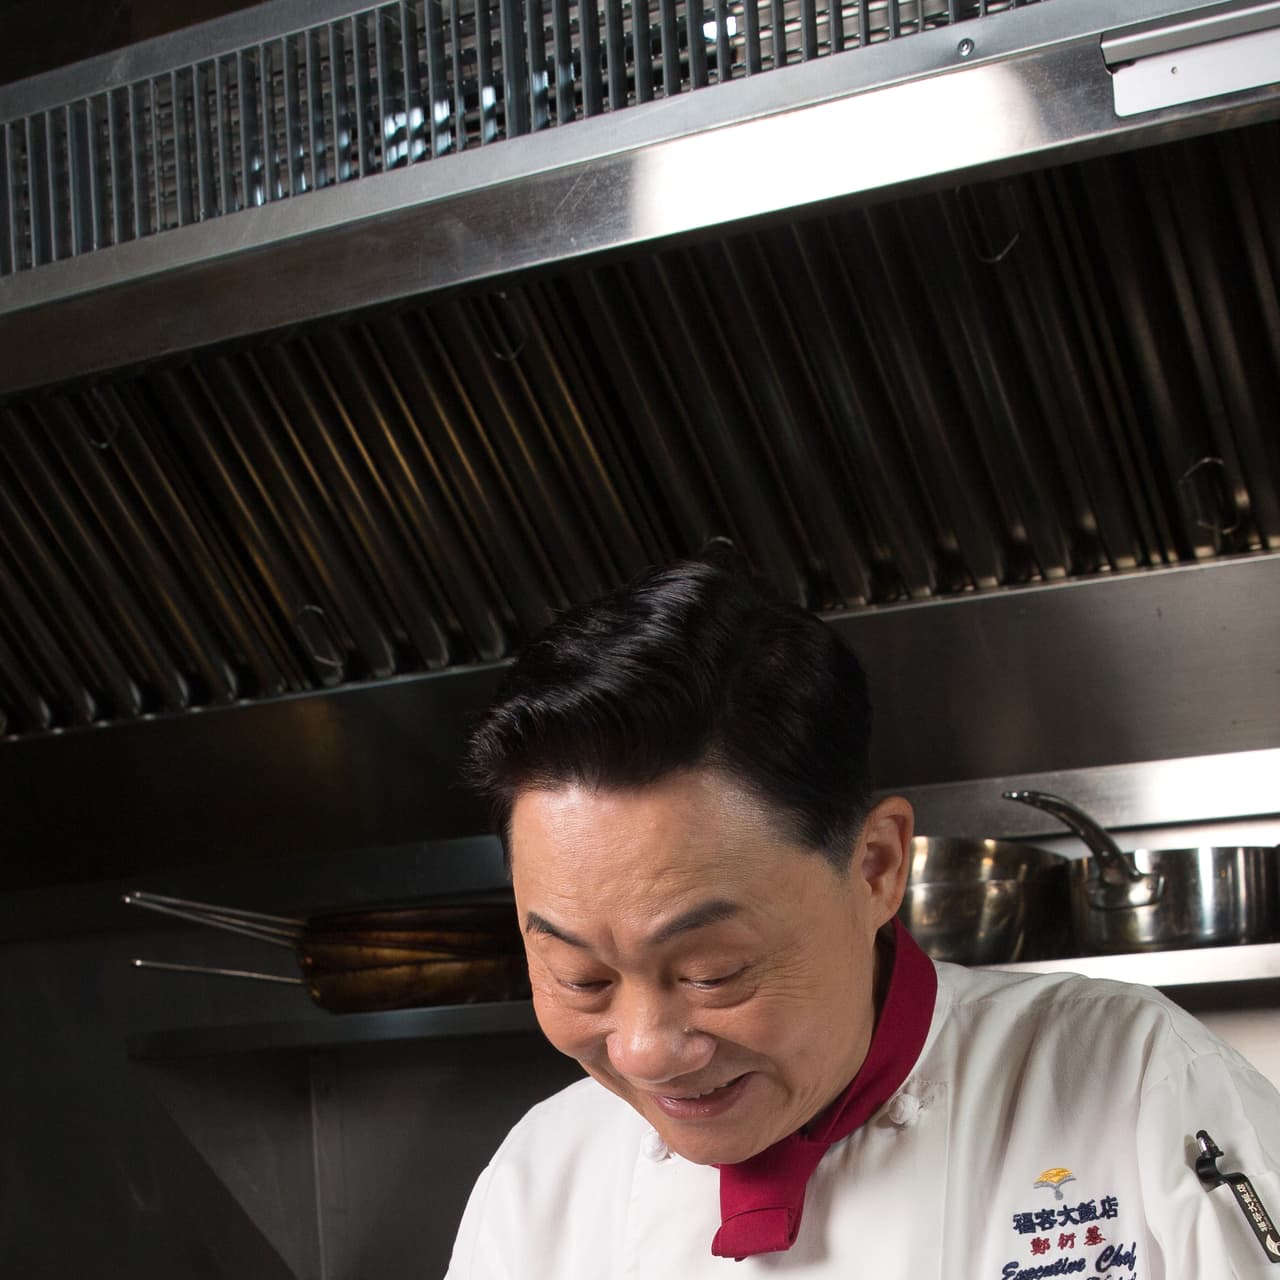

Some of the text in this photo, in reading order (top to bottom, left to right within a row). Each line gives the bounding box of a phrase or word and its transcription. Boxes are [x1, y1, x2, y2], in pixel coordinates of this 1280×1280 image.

[1013, 1195, 1119, 1235] 福客大飯店
[1030, 1225, 1106, 1256] 鄭衍基
[1095, 1241, 1137, 1273] Chef
